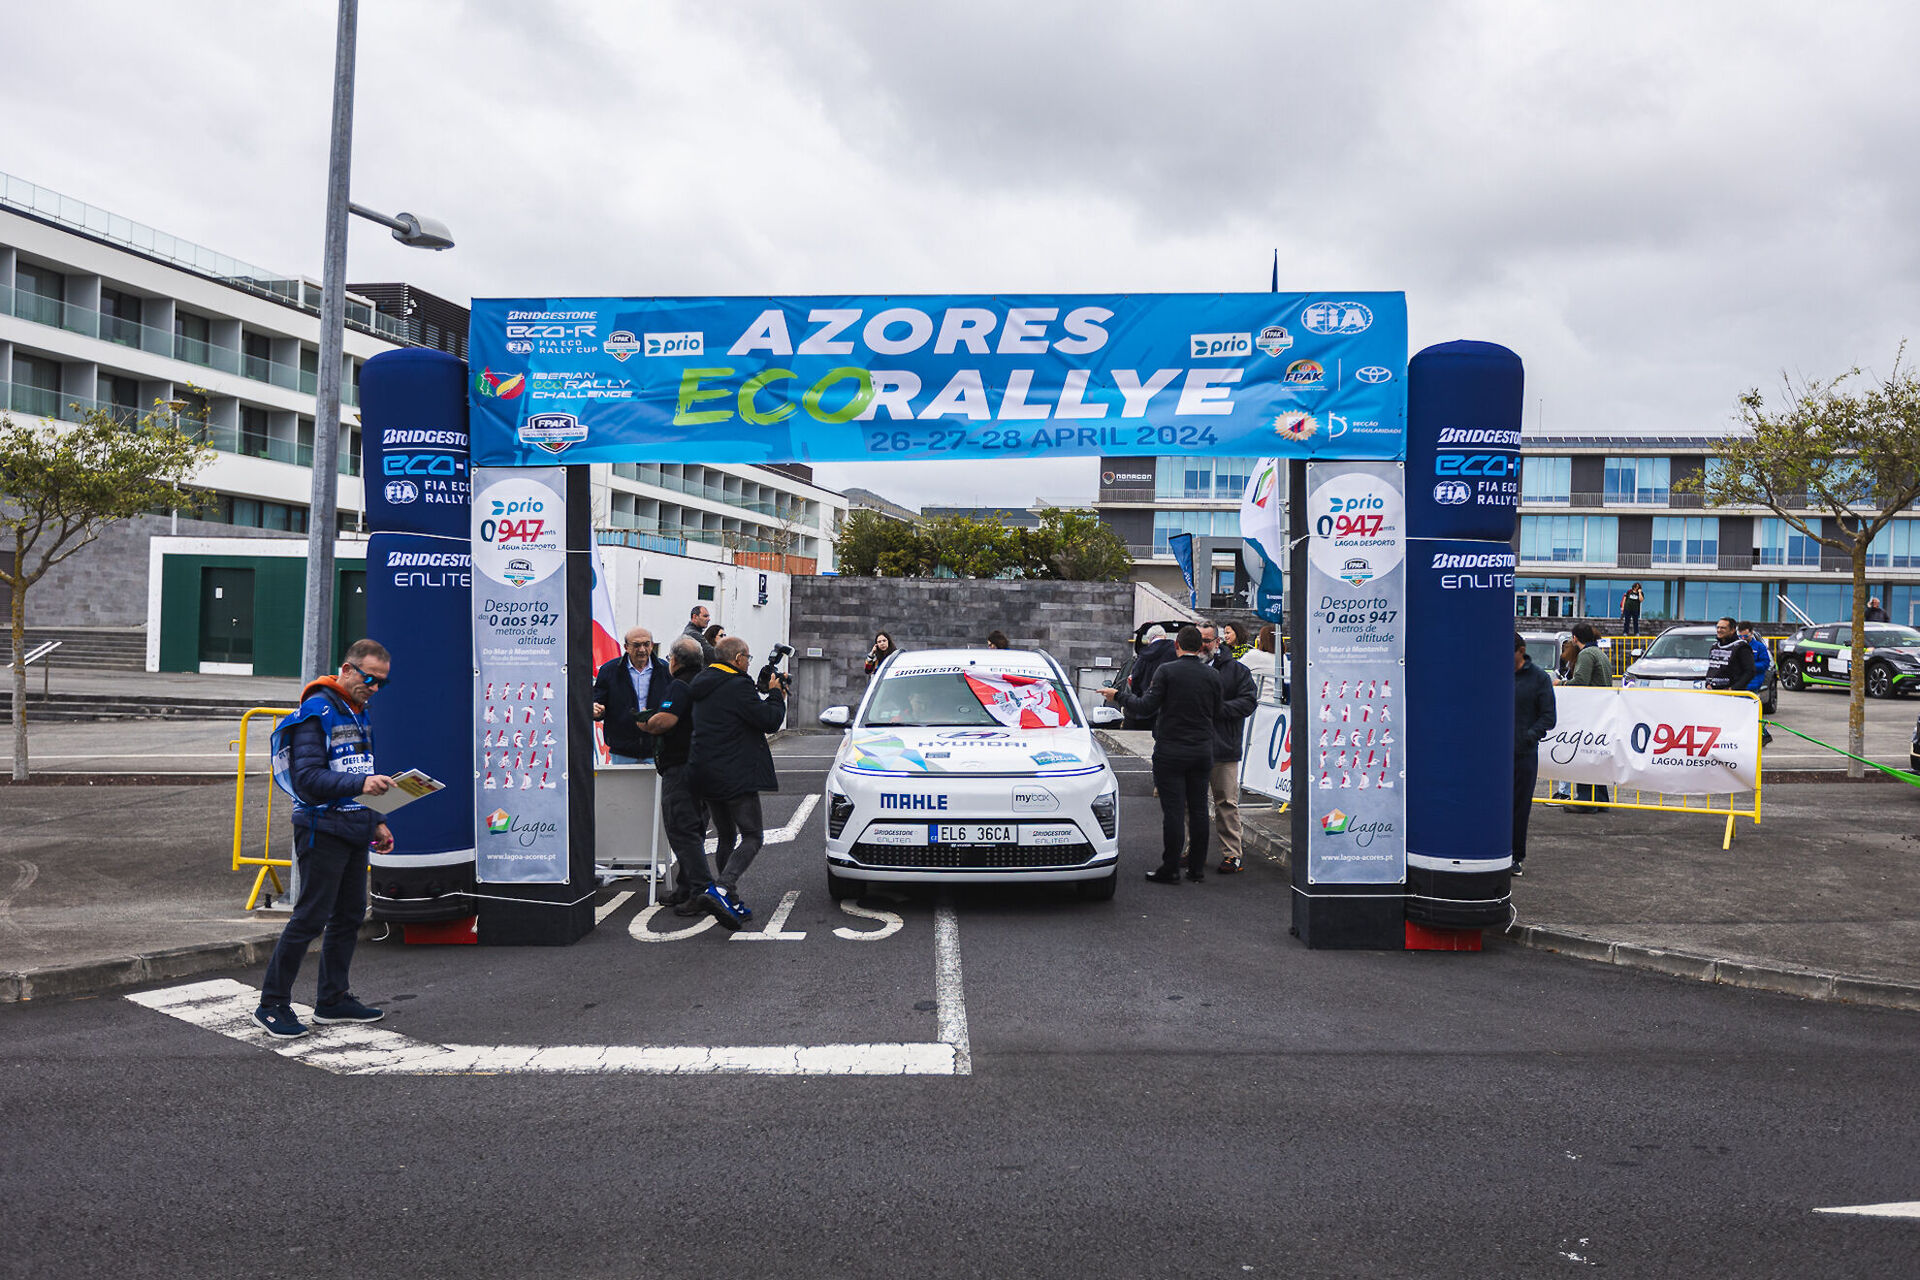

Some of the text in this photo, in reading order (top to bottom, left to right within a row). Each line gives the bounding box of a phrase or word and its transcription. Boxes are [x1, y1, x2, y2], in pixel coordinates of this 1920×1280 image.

[506, 311, 598, 320] BRIDGESTONE
[727, 307, 1114, 355] AZORES
[663, 335, 700, 354] prio
[1210, 335, 1248, 355] prio
[532, 372, 595, 380] IBERIAN
[1284, 373, 1323, 381] FPAK
[532, 390, 633, 399] CHALLENGE
[538, 419, 567, 428] FPAK
[870, 425, 1218, 451] 26-27-28 APRIL 2024
[425, 481, 447, 491] FIA
[1478, 481, 1498, 492] FIA
[425, 494, 464, 504] RALLY
[1346, 494, 1384, 512] prio
[1477, 494, 1511, 505] RALLY
[507, 497, 544, 515] prio
[760, 576, 765, 591] P
[484, 599, 549, 615] Desporto
[1321, 596, 1388, 612] Desporto
[489, 614, 498, 626] 0
[502, 617, 527, 627] aos
[531, 614, 559, 626] 947
[1326, 611, 1335, 623] 0
[1339, 614, 1365, 624] aos
[1369, 611, 1397, 623] 947
[495, 627, 538, 636] metros de
[1332, 624, 1376, 633] metros de
[518, 636, 556, 645] altitude
[1356, 633, 1395, 643] altitude
[895, 666, 965, 676] BRIDGESTO
[1720, 742, 1738, 750] mts
[1651, 757, 1738, 770] LAGOA DESPORTO
[880, 793, 948, 810] MAHLE
[1015, 793, 1050, 803] mybox
[511, 815, 557, 847] Lagoa
[941, 827, 966, 840] EL6
[977, 826, 1011, 840] 36CA
[1348, 815, 1394, 847] Lagoa
